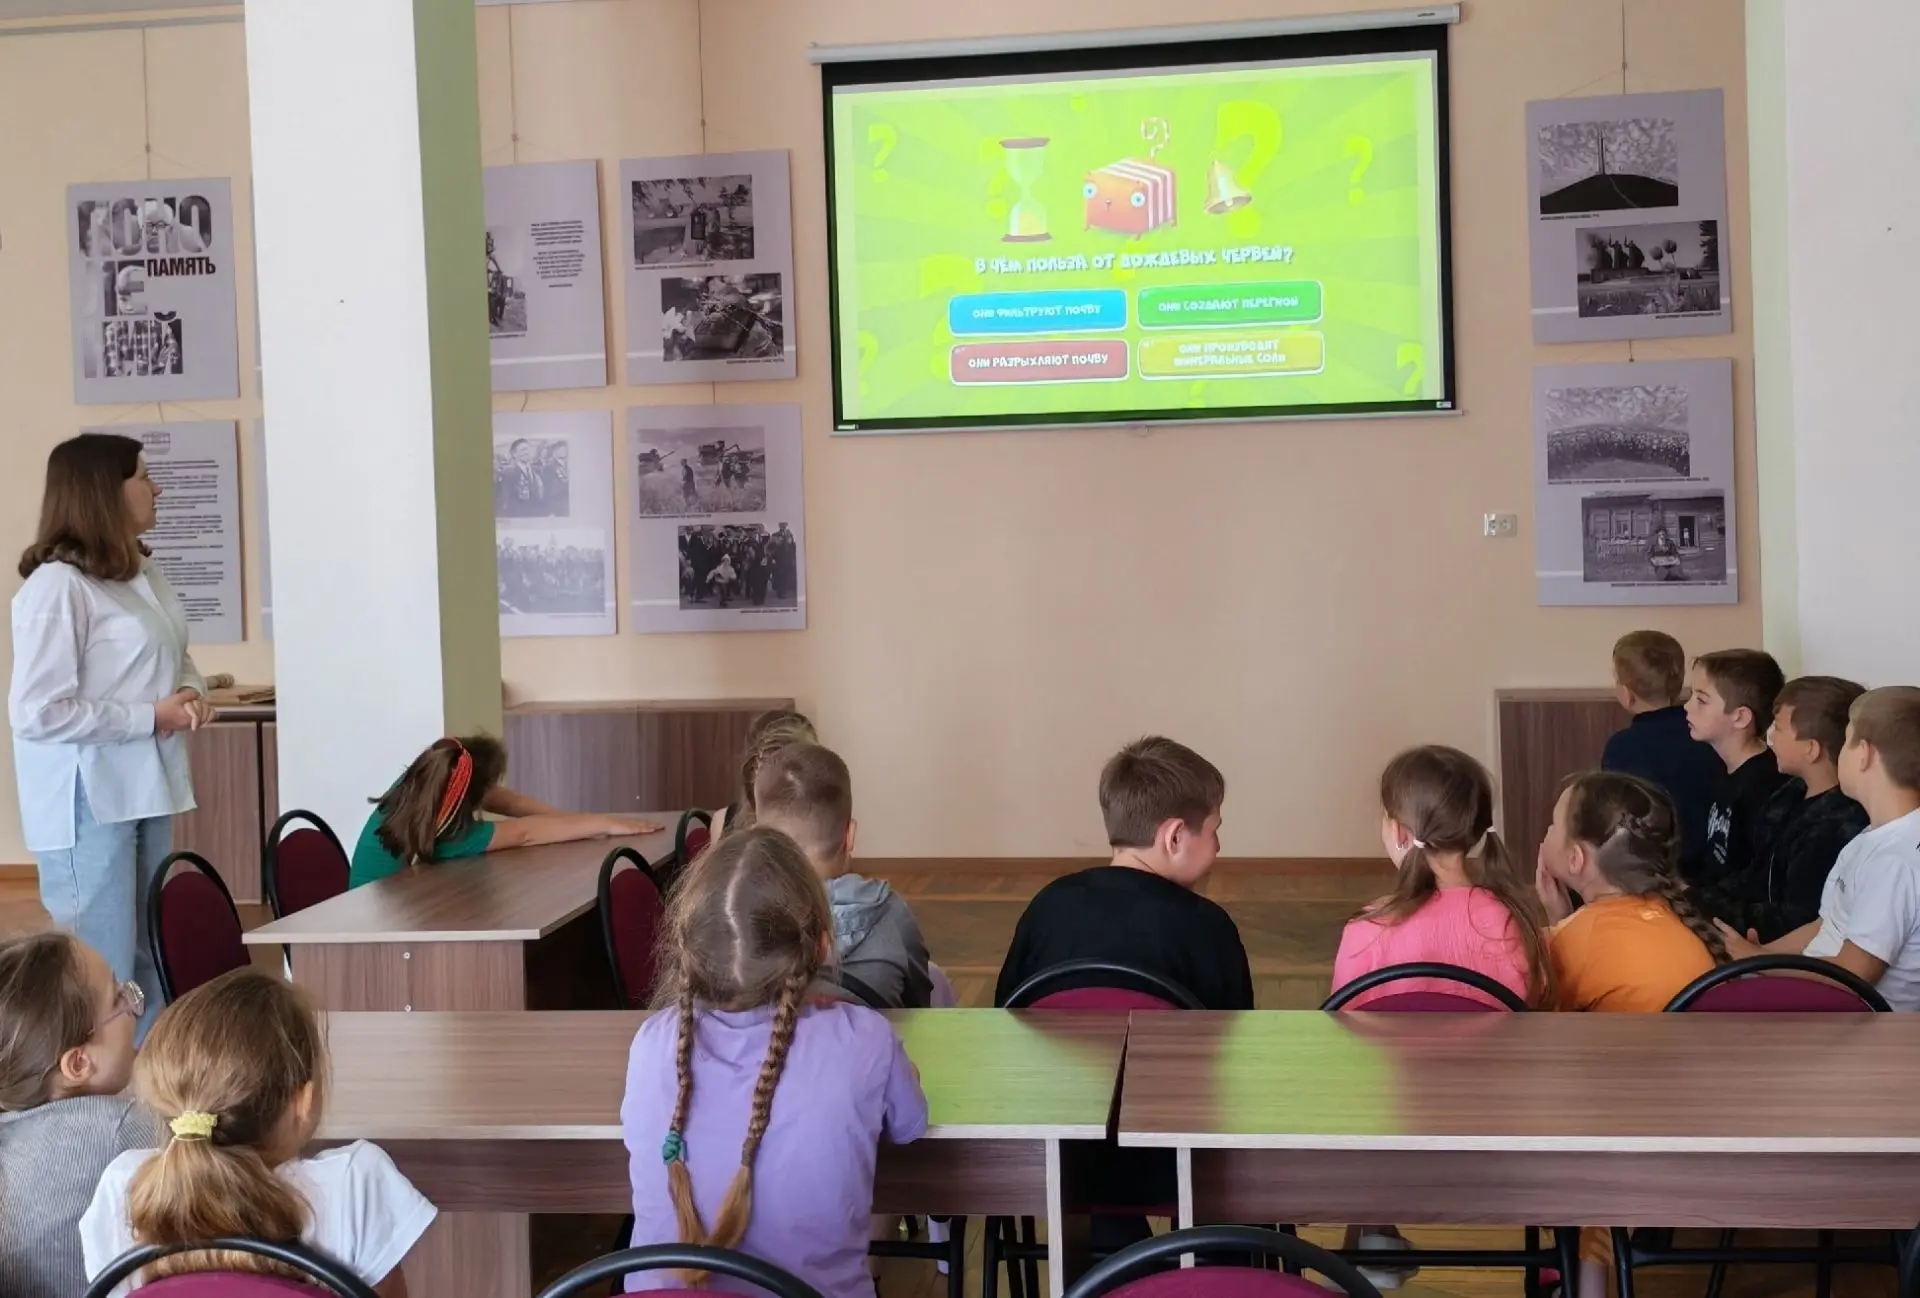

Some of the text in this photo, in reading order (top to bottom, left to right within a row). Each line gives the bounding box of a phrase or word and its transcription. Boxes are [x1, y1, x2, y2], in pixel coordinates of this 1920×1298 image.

[147, 256, 216, 277] ПАМЯТЬ
[975, 257, 987, 274] В
[1027, 253, 1088, 273] ПОЛЬЗА
[1092, 252, 1115, 269] ОТ
[1121, 249, 1216, 268] ДОЖДЕВЫХ
[1222, 245, 1294, 265] ЧЕРВЕЙ?
[973, 304, 1102, 319] ОНИ ФИЛЬТРУЮТ ПОЧВУ
[1158, 302, 1181, 312] ОНИ
[969, 353, 1108, 369] ОНИ РАЗРЫХЛЯЮТ ПОЧВУ
[1257, 352, 1286, 364] СОЛИ
